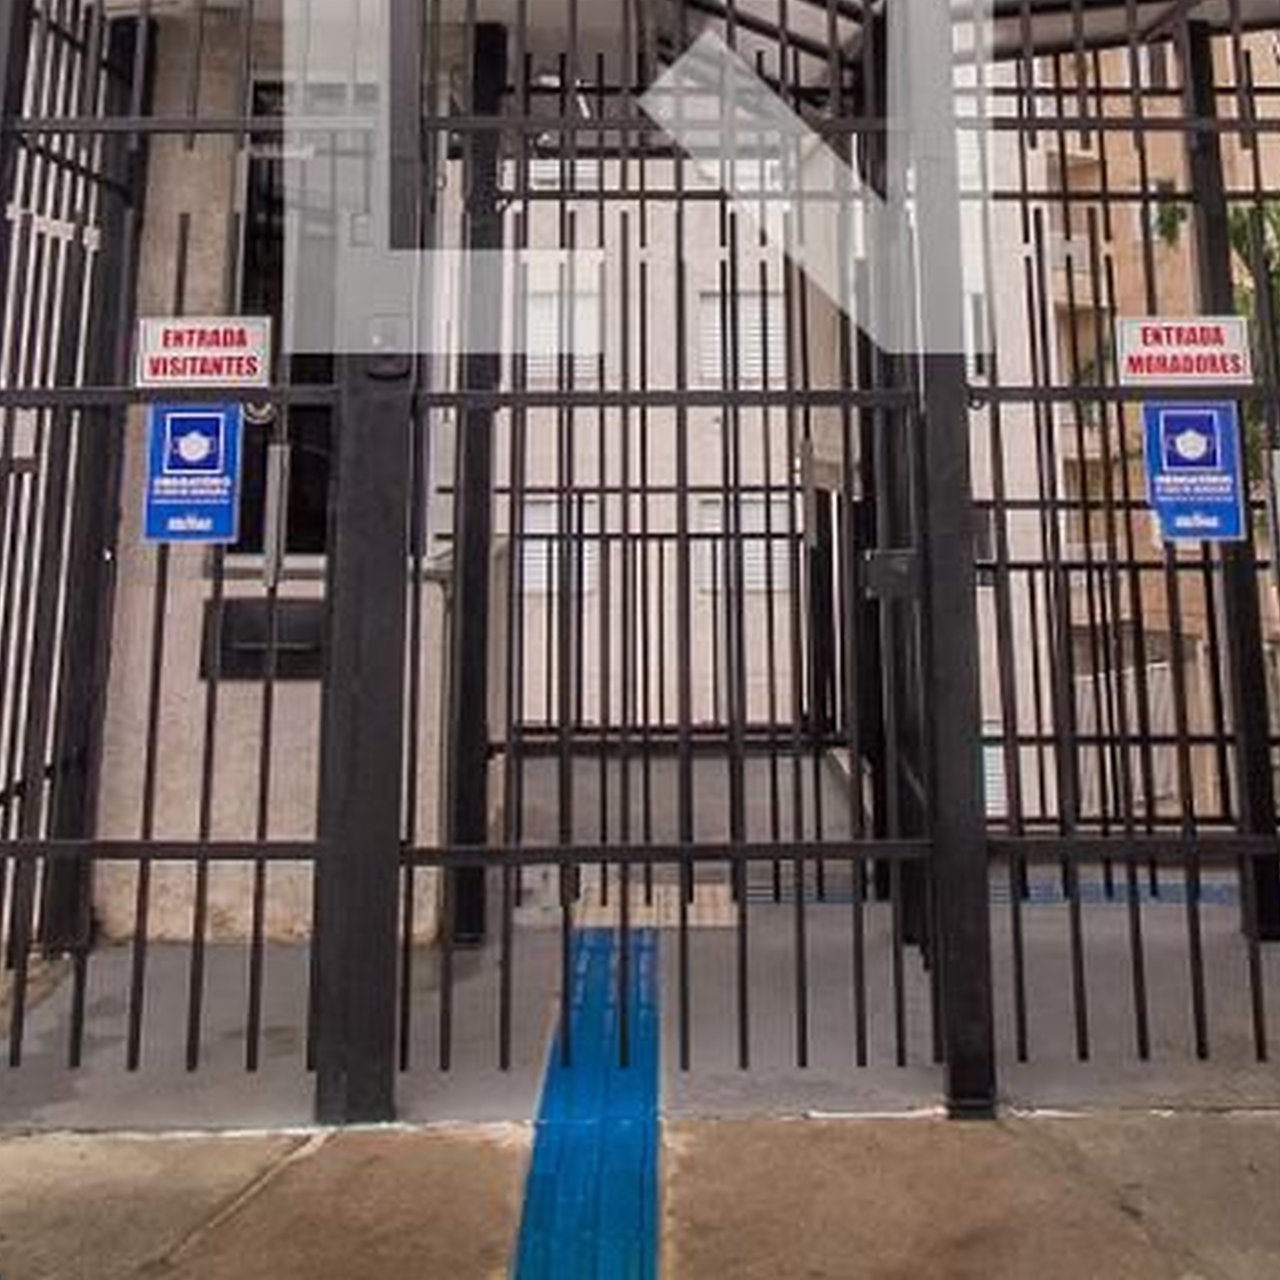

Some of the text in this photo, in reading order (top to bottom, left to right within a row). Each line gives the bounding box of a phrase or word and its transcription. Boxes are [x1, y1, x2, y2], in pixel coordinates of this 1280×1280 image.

[162, 328, 247, 347] ENTRADA
[1142, 326, 1225, 345] ENTRADA
[149, 356, 258, 376] VISITANTES
[1127, 354, 1241, 373] MORADORES
